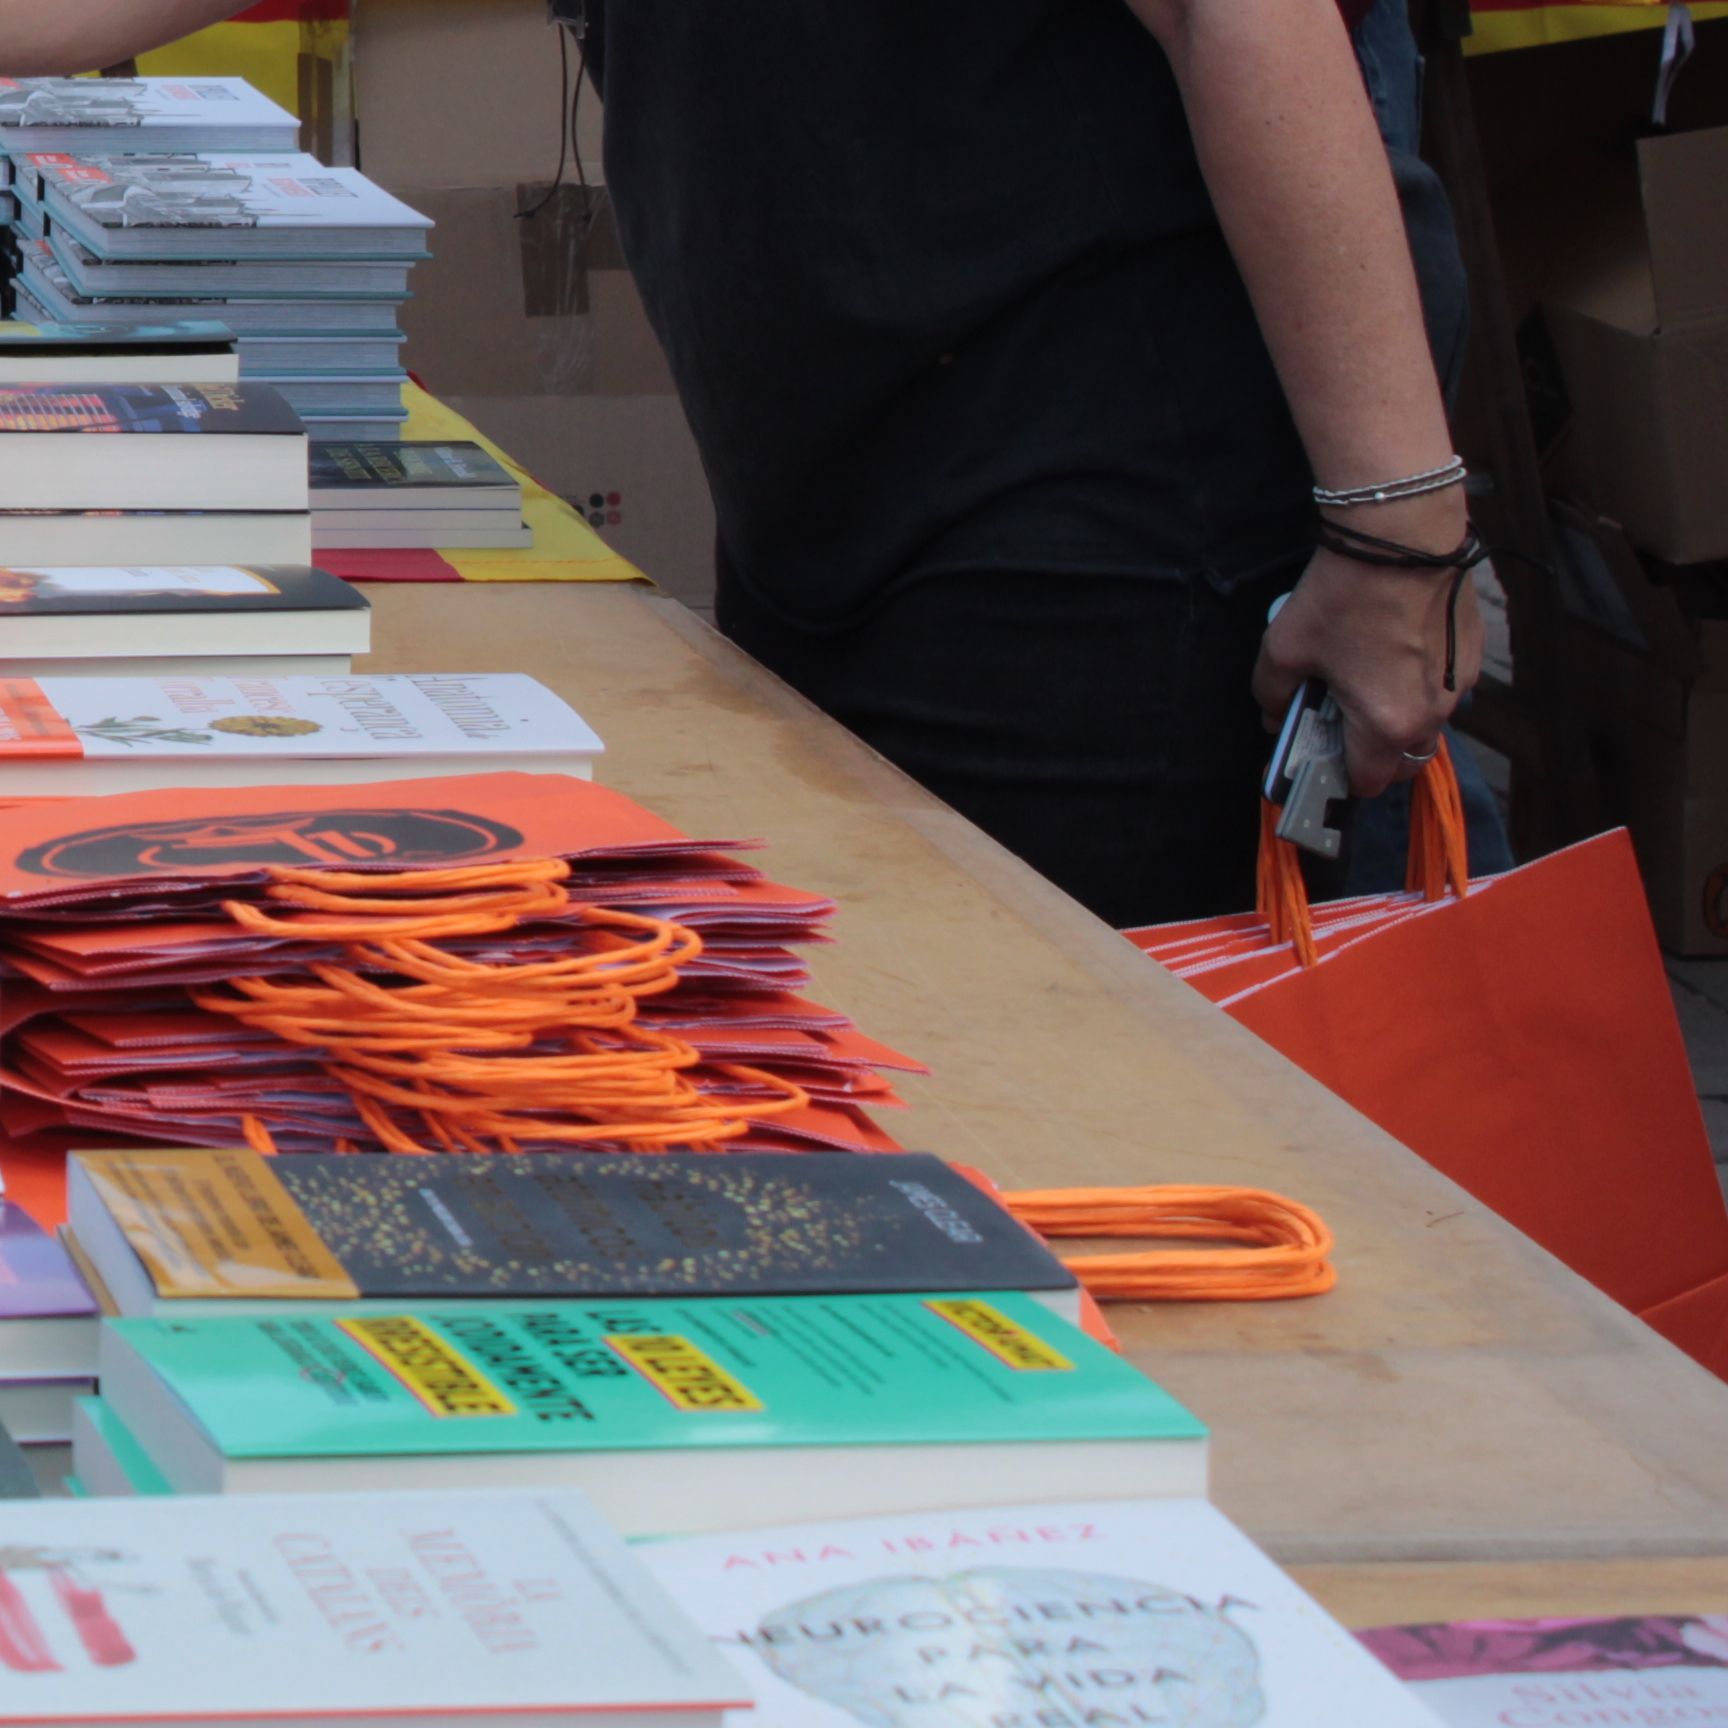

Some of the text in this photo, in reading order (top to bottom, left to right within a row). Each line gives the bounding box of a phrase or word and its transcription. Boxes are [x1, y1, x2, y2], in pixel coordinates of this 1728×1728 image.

[510, 1312, 630, 1378] PARA SER
[586, 1309, 662, 1335] LAS
[645, 1356, 744, 1407] LEYES
[722, 1521, 1109, 1572] ANA IBÁÑEZ
[706, 1592, 1262, 1651] NEUROCIENCIA
[920, 1632, 1109, 1666] PARA
[897, 1663, 1191, 1706] LA VIDA
[994, 1703, 1166, 1728] REAL
[1499, 1703, 1728, 1728] Congos
